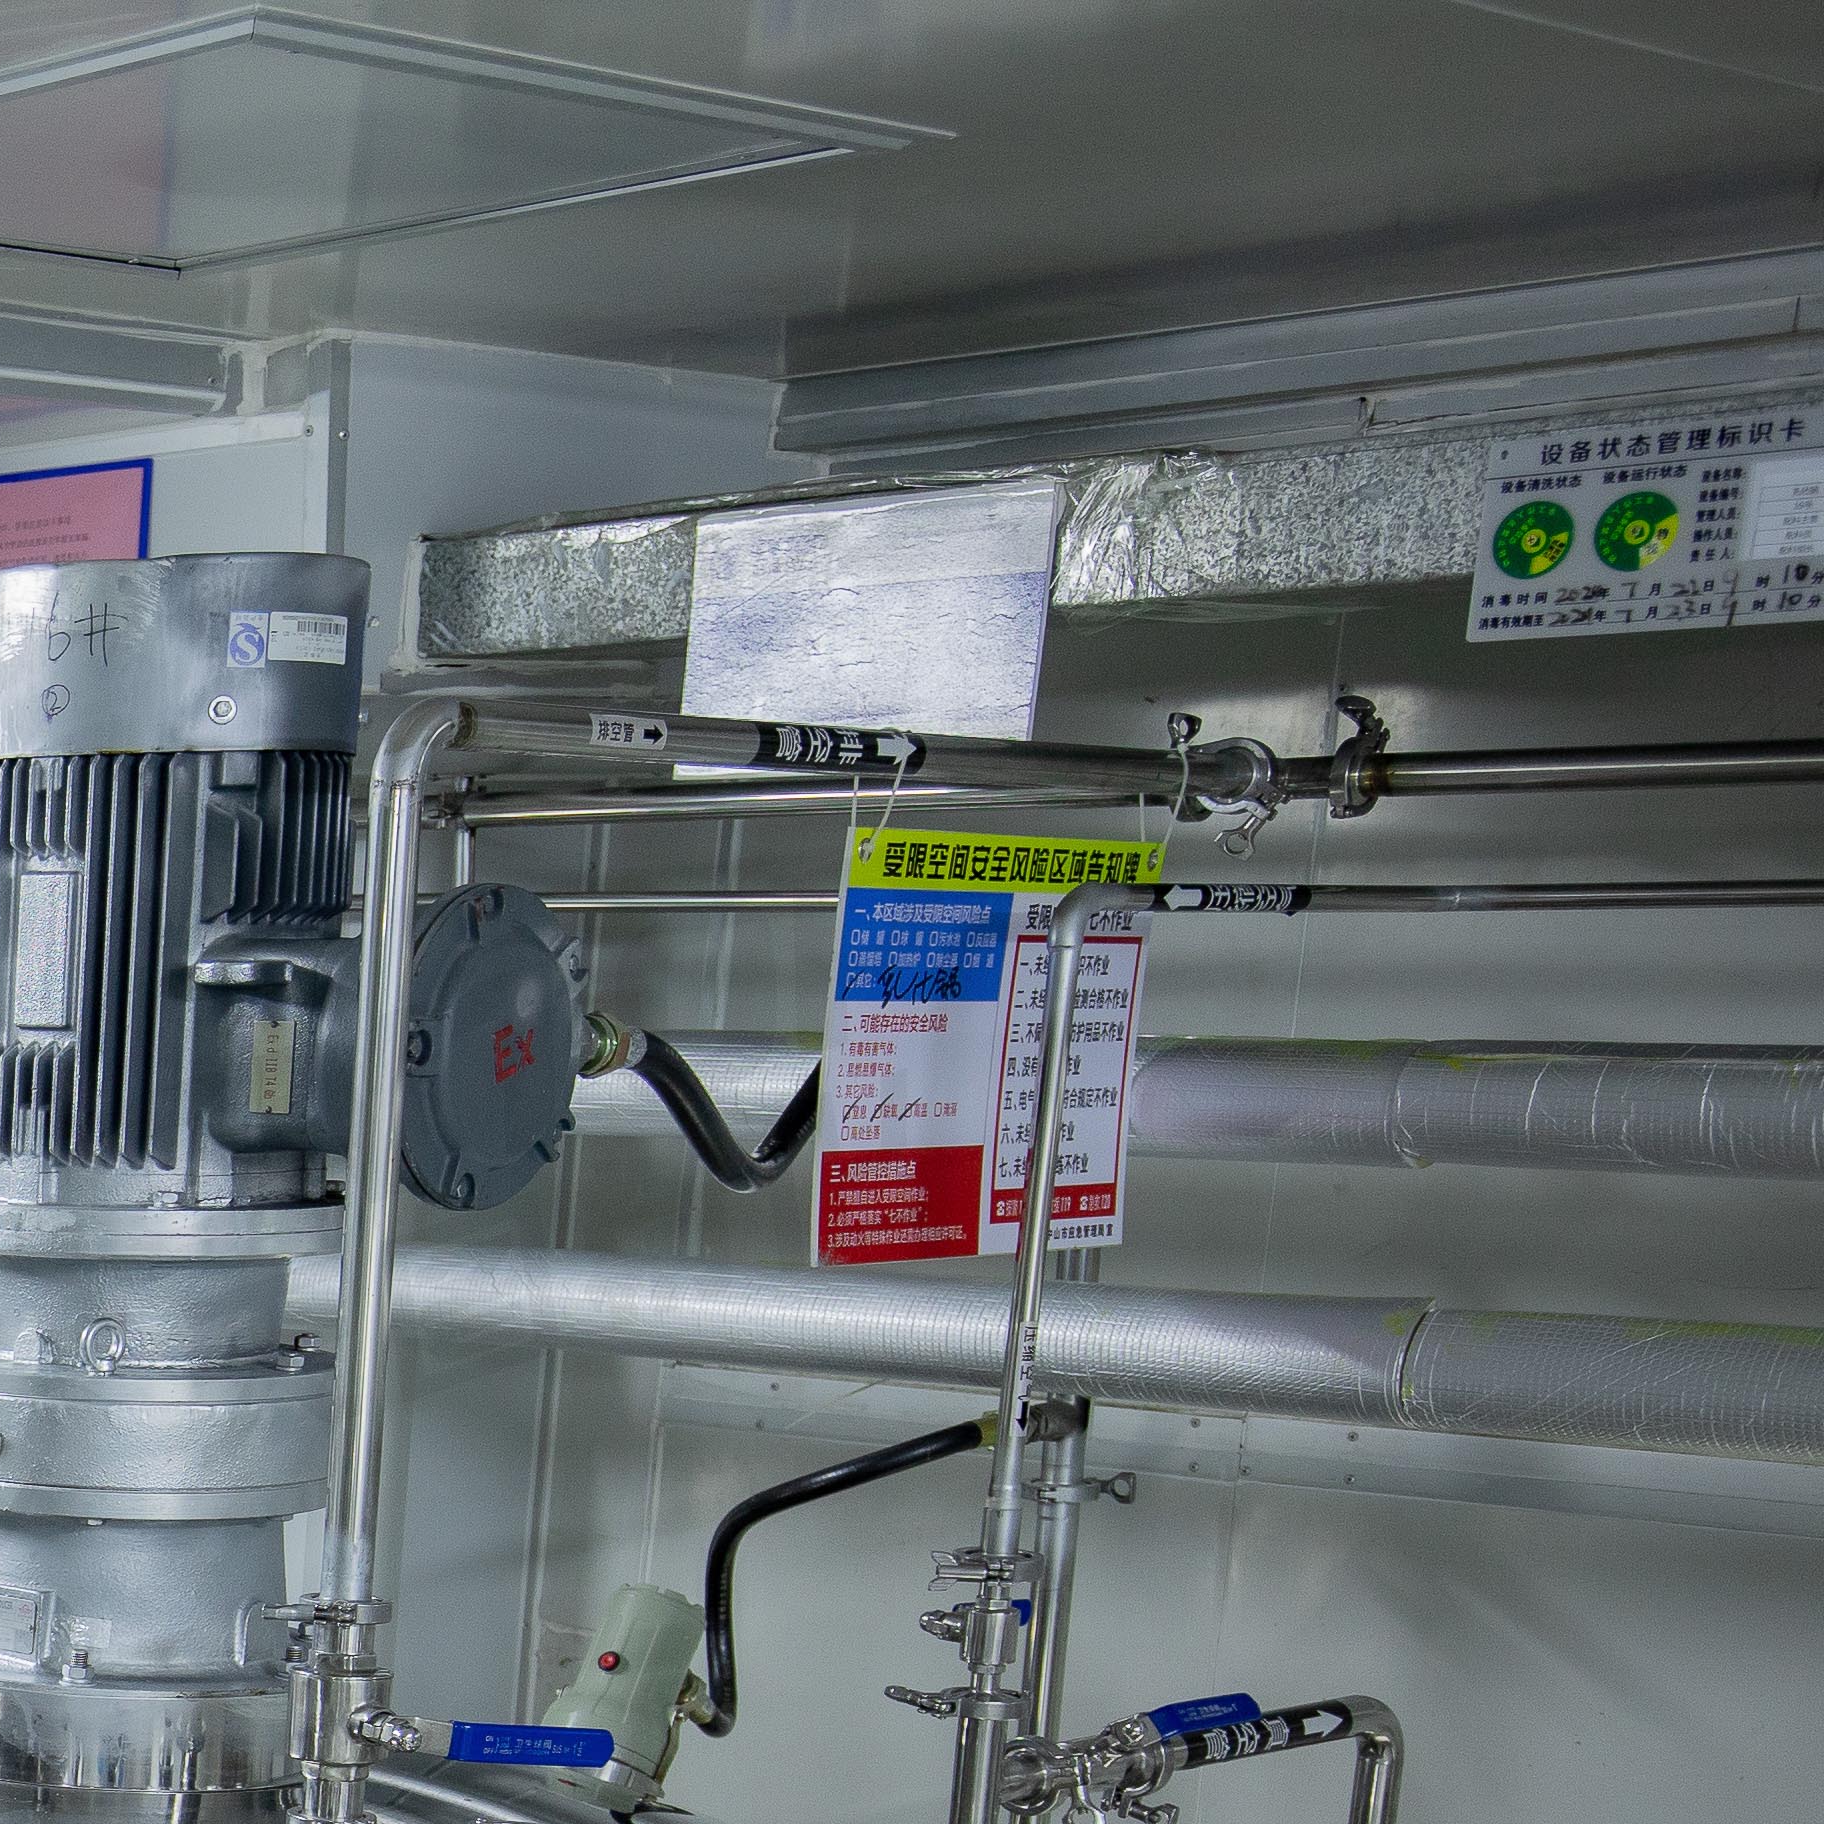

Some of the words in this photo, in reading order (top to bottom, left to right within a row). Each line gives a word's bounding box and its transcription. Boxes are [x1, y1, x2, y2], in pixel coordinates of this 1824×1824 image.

[1540, 418, 1805, 466] 设备状态管理标识卡
[494, 1023, 537, 1084] Ex
